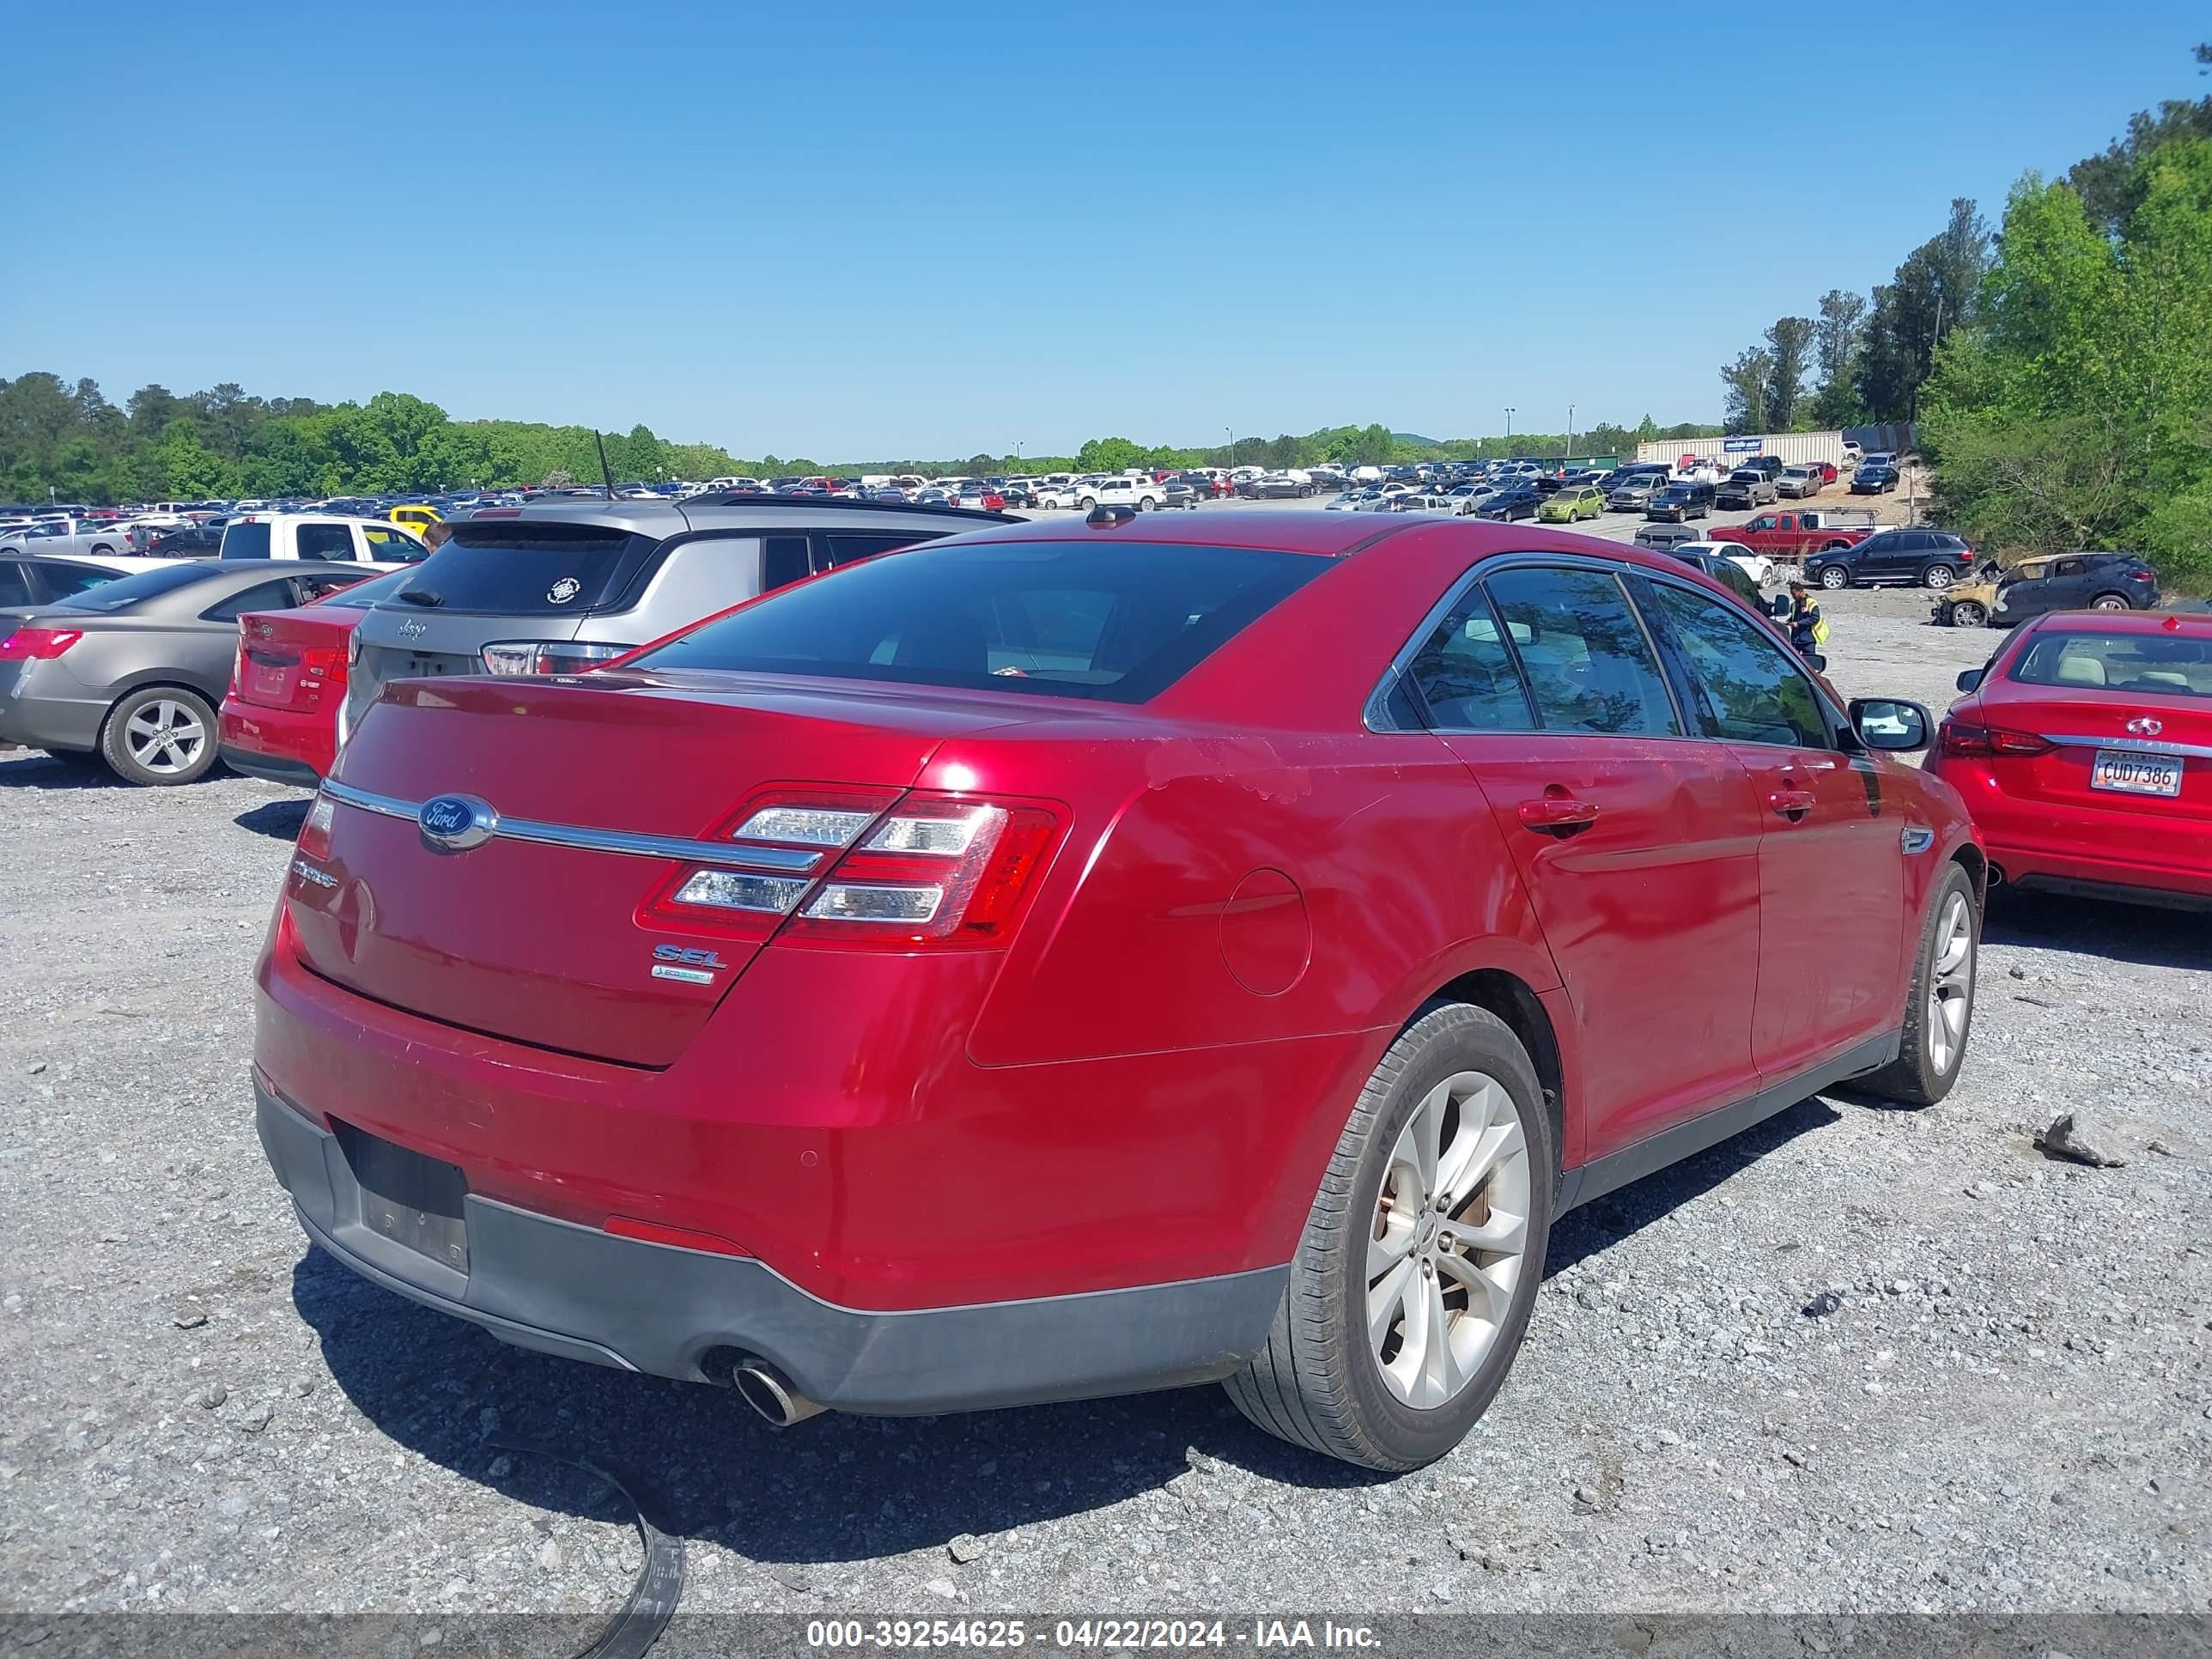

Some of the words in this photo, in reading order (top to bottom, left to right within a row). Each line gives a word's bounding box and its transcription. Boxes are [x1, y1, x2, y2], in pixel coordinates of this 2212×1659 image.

[2104, 761, 2172, 786] CUD7386
[426, 801, 462, 829] Ford
[653, 945, 728, 969] SEL
